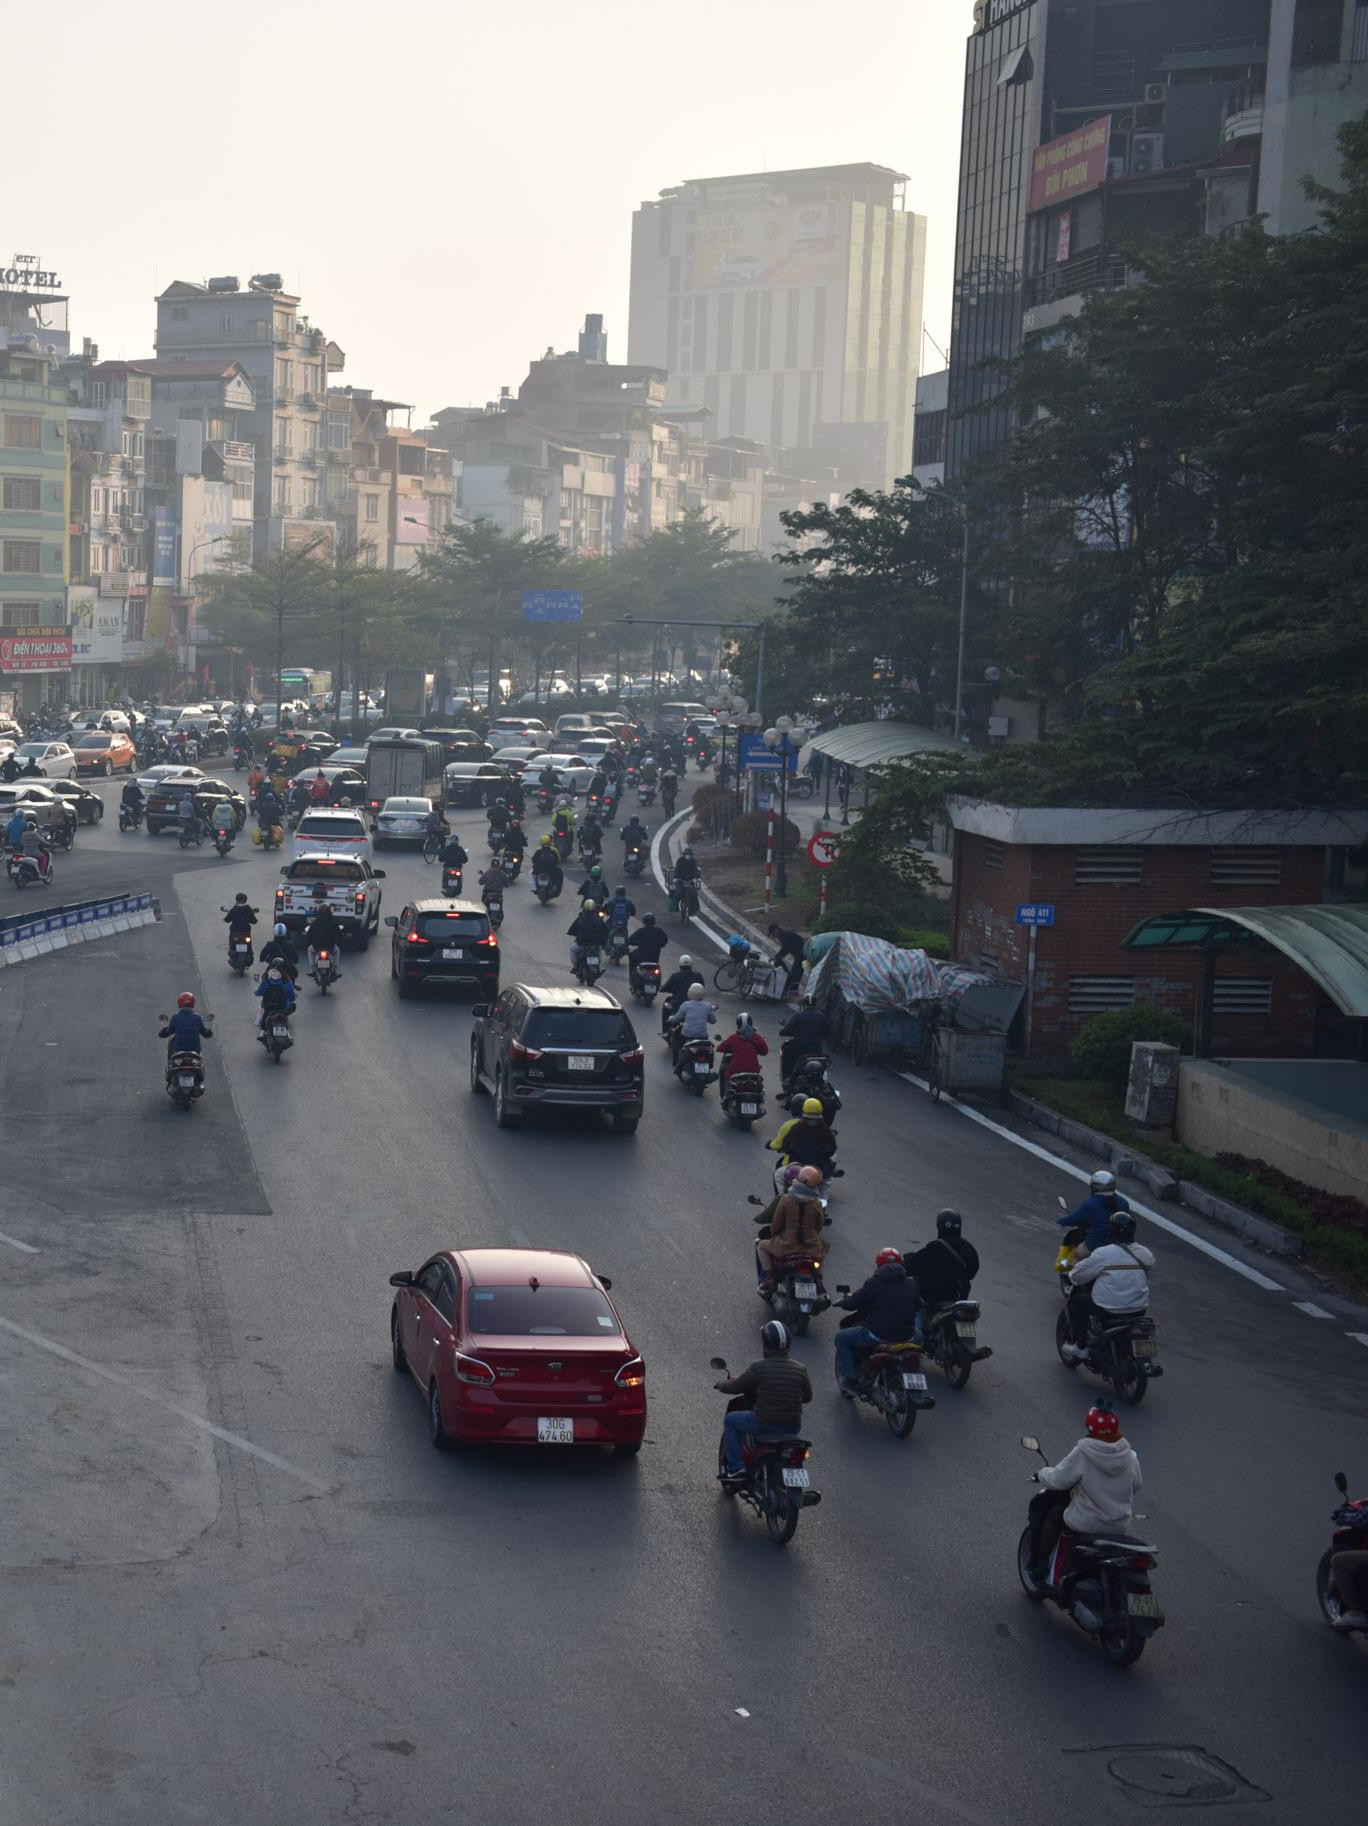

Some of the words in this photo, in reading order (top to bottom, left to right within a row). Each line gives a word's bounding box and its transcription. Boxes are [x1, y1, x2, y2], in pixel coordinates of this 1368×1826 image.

[13, 641, 30, 658] ĐIỆN
[32, 642, 53, 657] THOẠI
[1021, 906, 1035, 918] NGÕ
[546, 1418, 565, 1430] 30G
